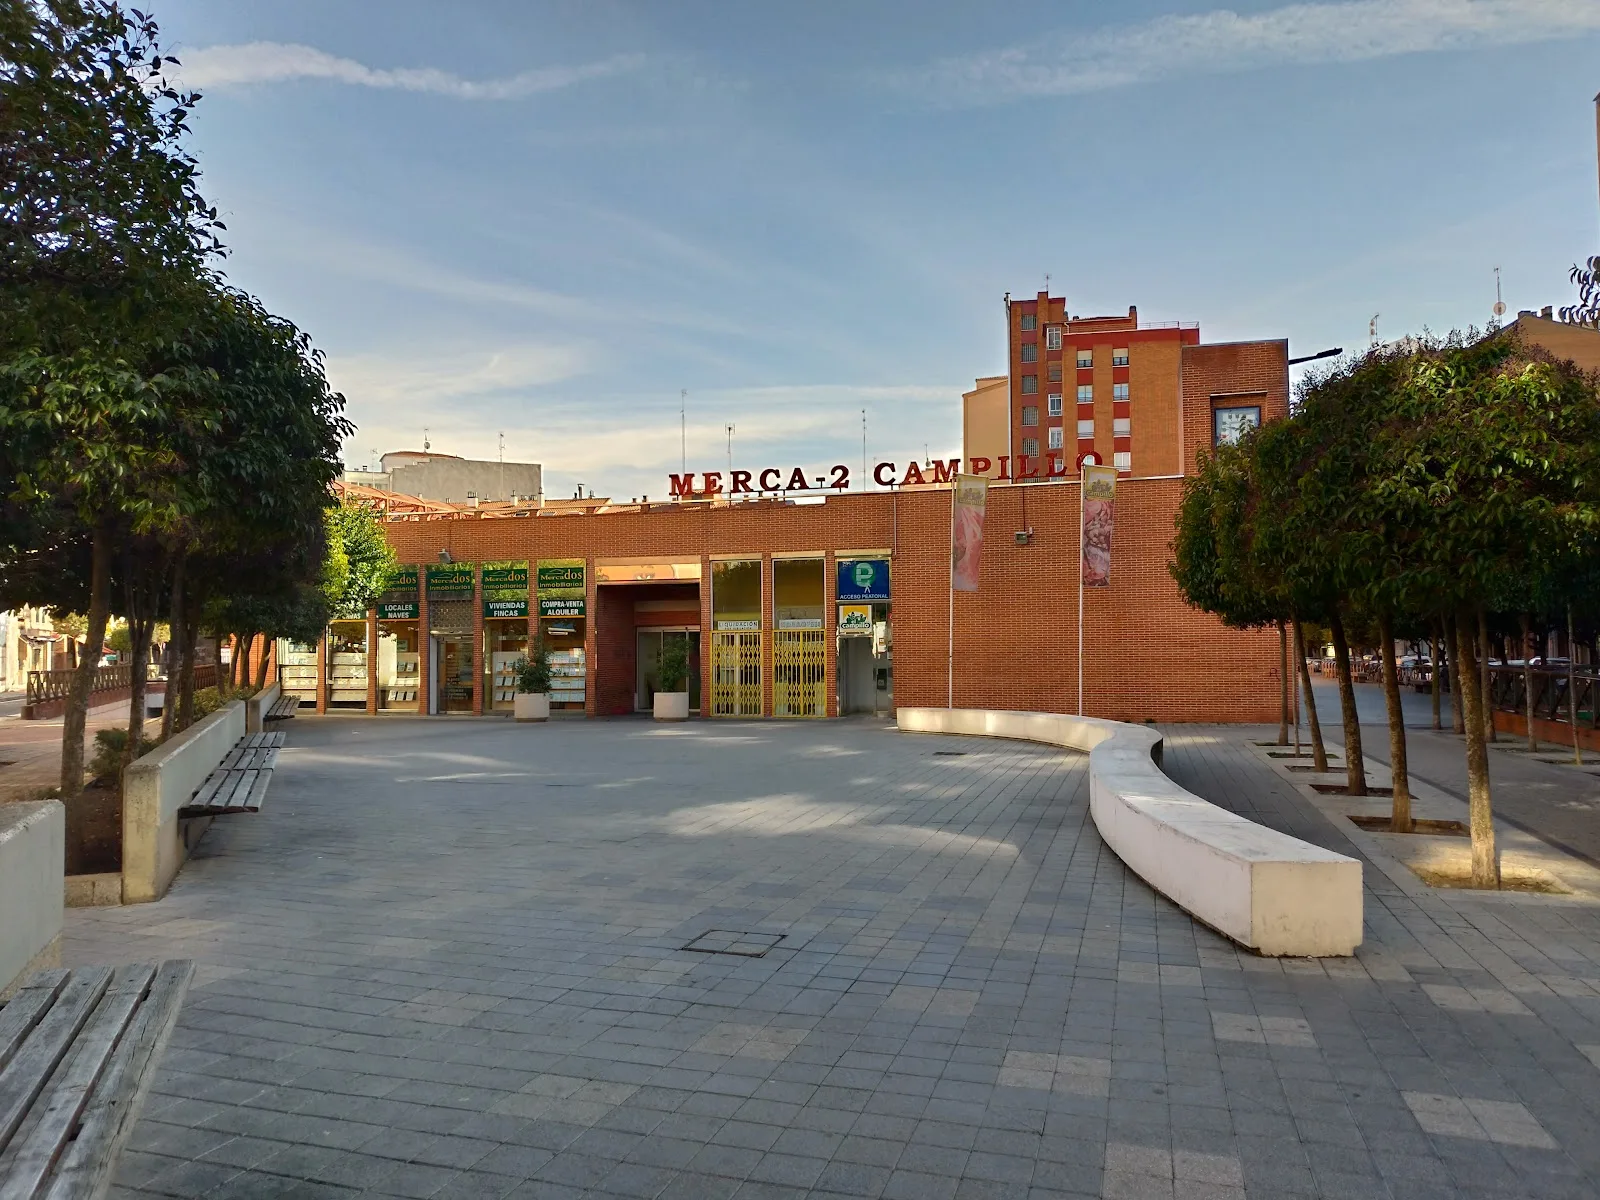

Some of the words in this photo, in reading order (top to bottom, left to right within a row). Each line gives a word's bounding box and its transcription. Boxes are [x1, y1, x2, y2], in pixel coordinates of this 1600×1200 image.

[667, 464, 850, 497] MERCA-2
[872, 450, 1103, 486] CAMPILLO
[484, 570, 526, 582] Mercados
[540, 568, 583, 580] Mercados
[384, 604, 413, 612] LOCALES
[488, 601, 526, 610] VIVIENDAS
[541, 600, 584, 608] COMPRA-VENTA
[546, 608, 579, 616] ALQUILER
[841, 621, 870, 630] campillo
